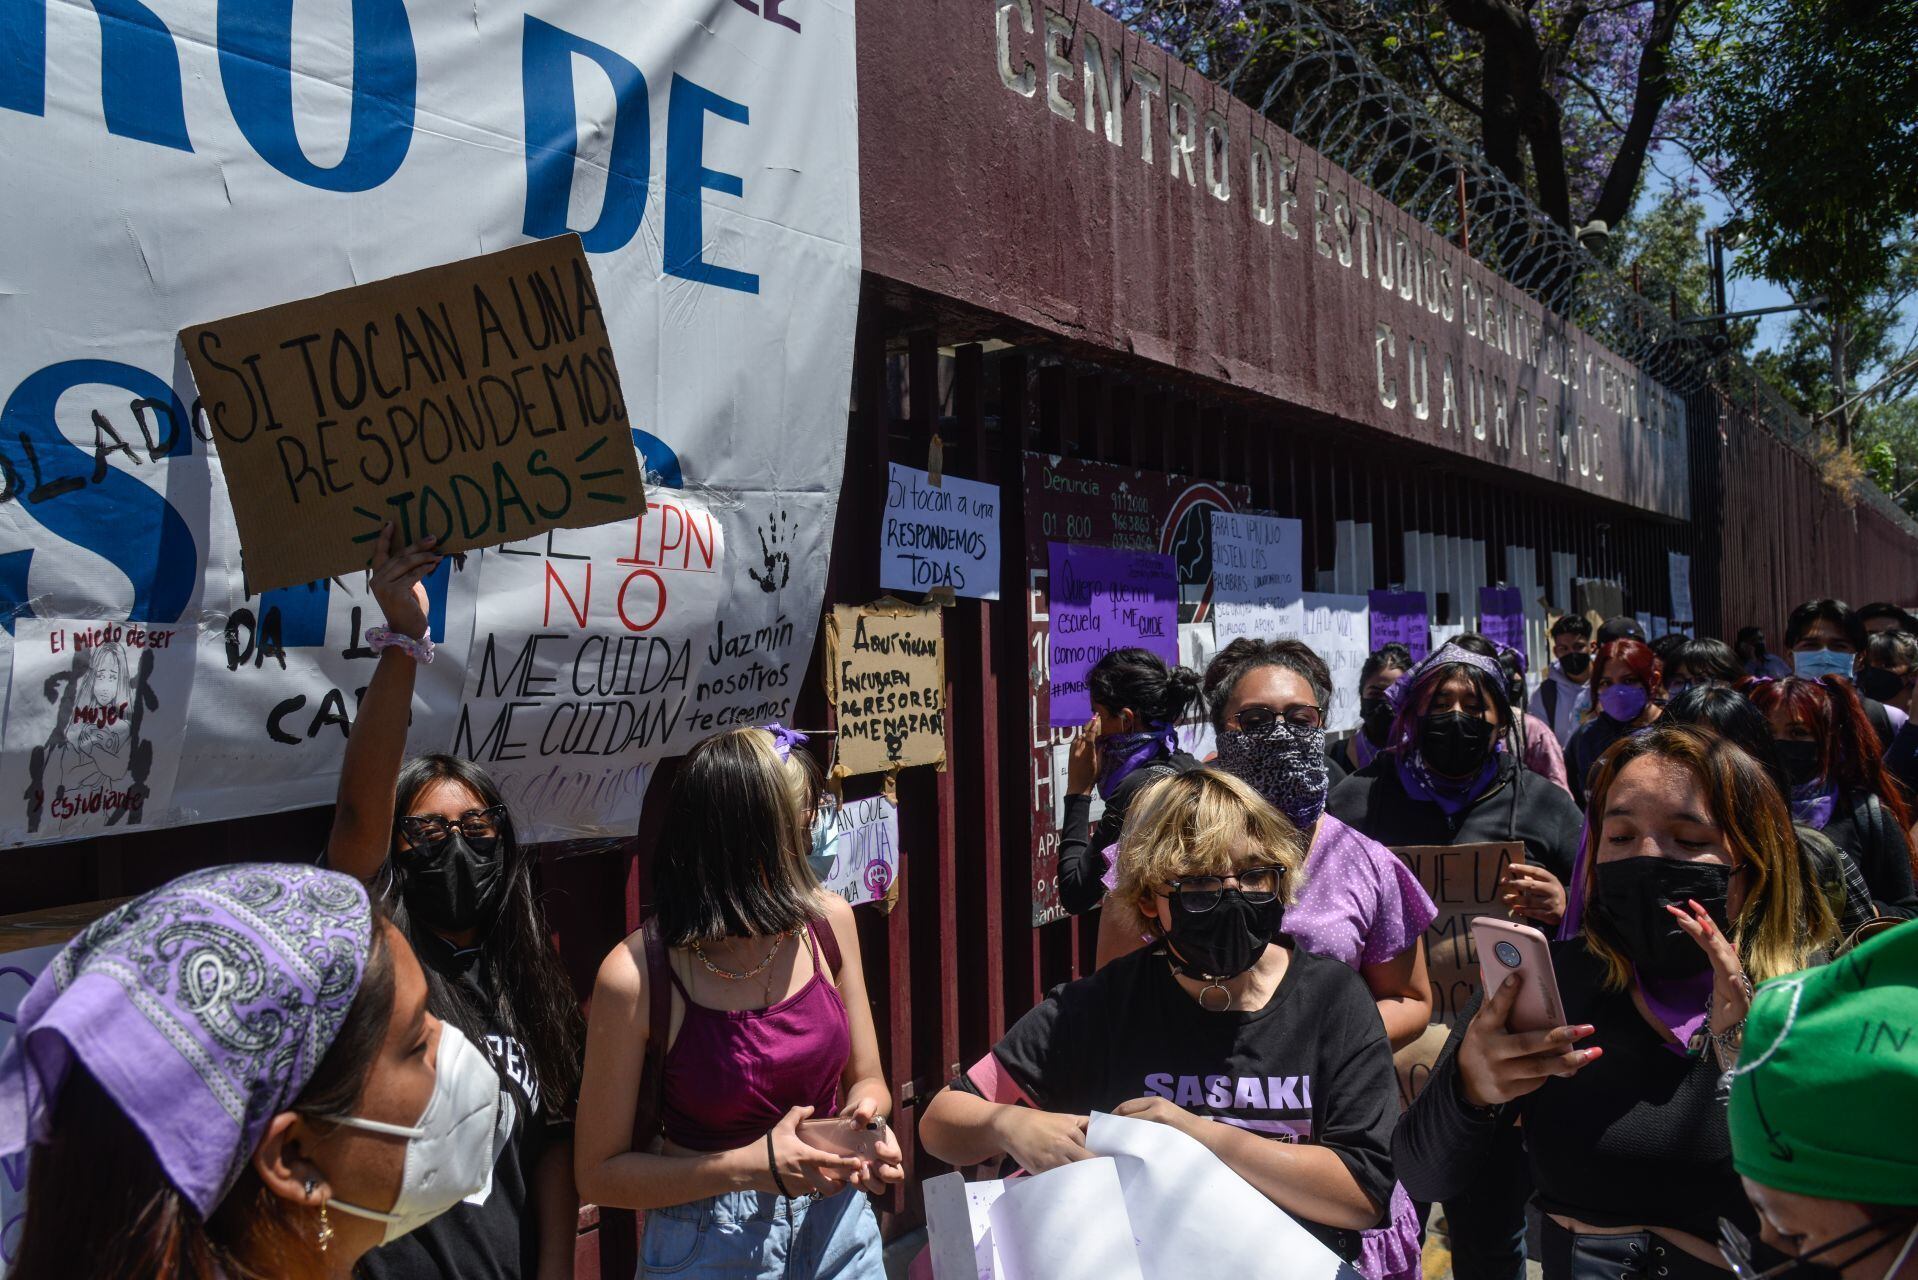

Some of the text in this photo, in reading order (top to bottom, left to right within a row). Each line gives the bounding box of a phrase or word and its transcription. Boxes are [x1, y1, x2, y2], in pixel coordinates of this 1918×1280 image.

[523, 14, 760, 295] DE
[996, 2, 1230, 201] CENTRO
[1251, 135, 1299, 240] DE
[1315, 174, 1454, 322] ESTUDIOS
[199, 257, 606, 443] SI TOCAN A UNA
[277, 346, 626, 503] RESPONDEMOS
[386, 449, 571, 547] TODAS
[889, 466, 994, 519] Si tocan a una
[1043, 466, 1100, 496] Denuncia
[617, 503, 715, 569] IPN
[887, 518, 986, 561] RESPONDEMOS
[1066, 514, 1091, 538] 800
[897, 553, 965, 590] TODAS
[50, 628, 65, 654] El
[148, 629, 176, 649] ser
[708, 614, 794, 665] Jazmín
[1057, 607, 1165, 636] escuela ME CUIDE
[476, 632, 691, 698] ME CUIDA
[1054, 645, 1086, 666] como
[697, 662, 789, 702] nosotros
[841, 660, 911, 694] ENCUBREN
[686, 697, 790, 733] te creemos
[840, 687, 940, 718] AGRESORES
[453, 696, 686, 762] ME CUIDAN
[51, 786, 144, 820] estudiante
[858, 796, 889, 825] QUE
[1143, 1072, 1313, 1110] SASAKI
